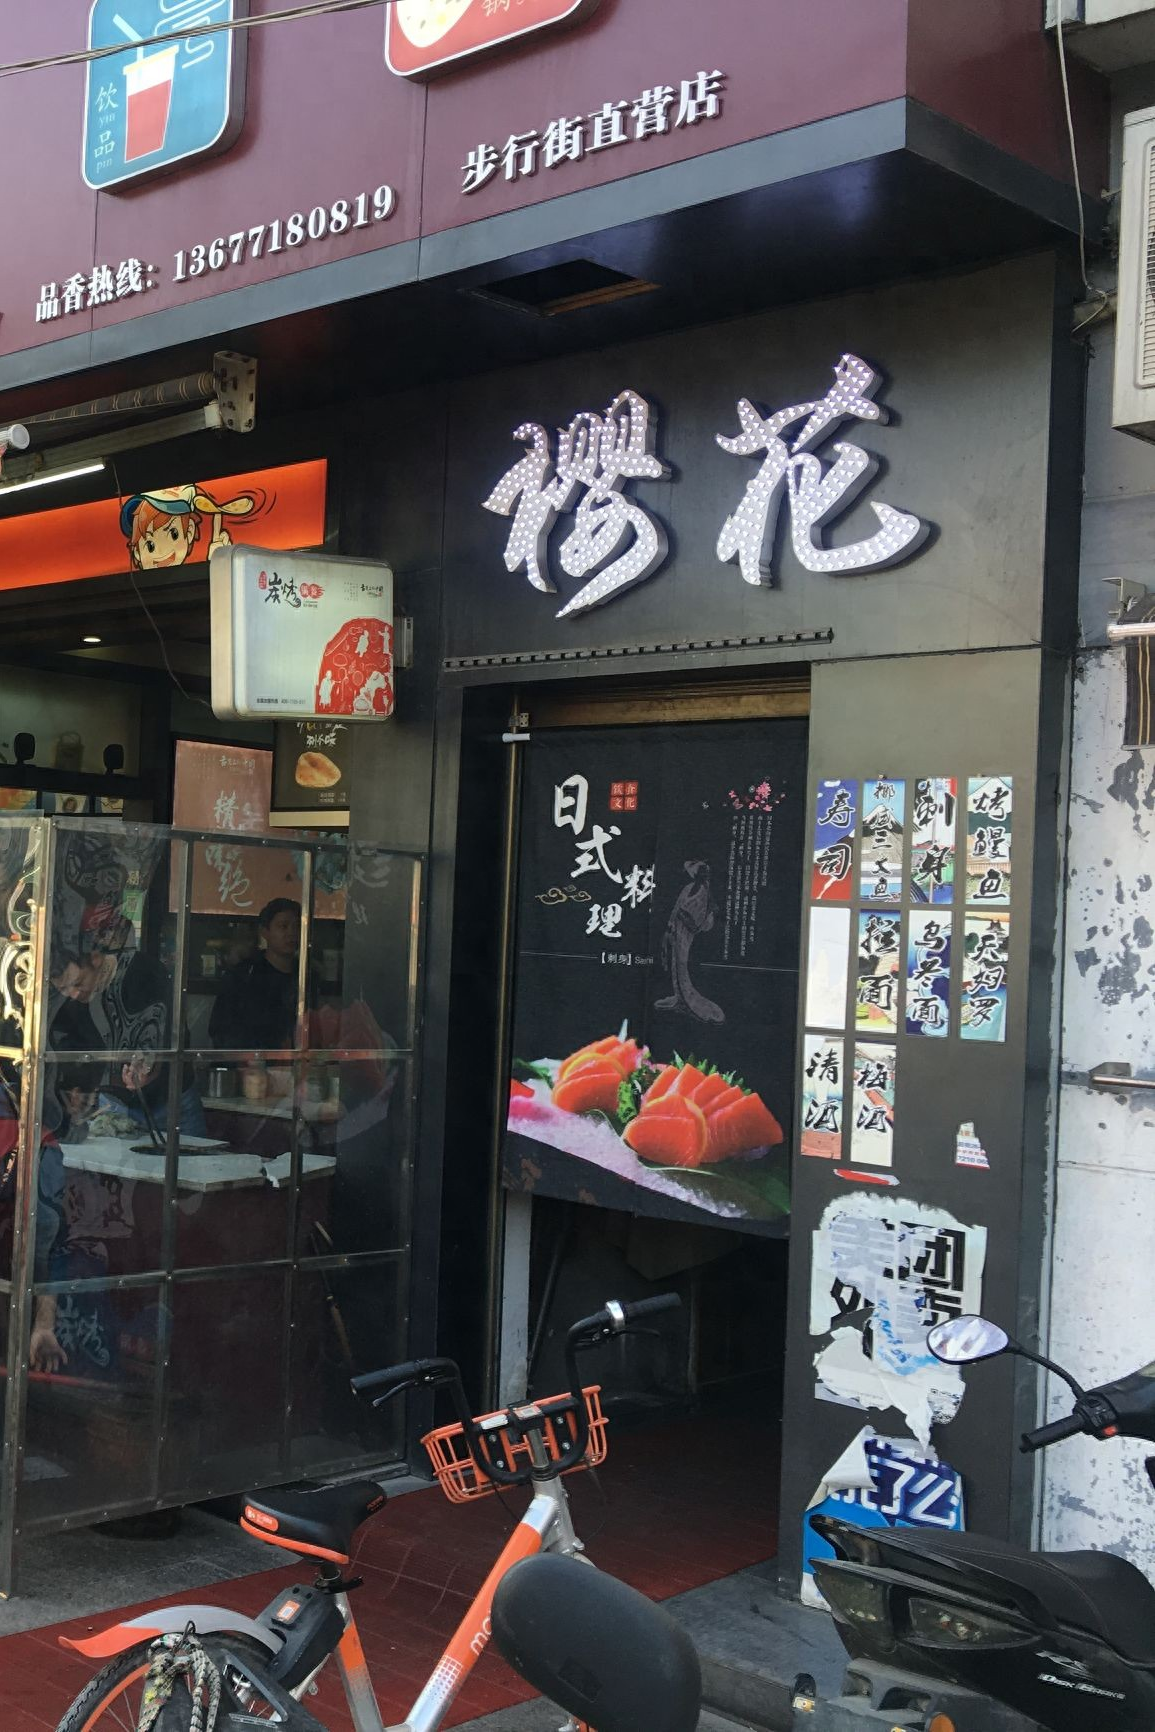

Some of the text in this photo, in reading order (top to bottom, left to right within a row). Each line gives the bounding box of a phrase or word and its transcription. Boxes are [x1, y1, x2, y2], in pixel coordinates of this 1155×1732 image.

[462, 69, 725, 193] 步行街直营店
[173, 185, 395, 282] 13677180819
[554, 774, 656, 938] 日式料理
[818, 788, 855, 881] 寿司
[916, 792, 956, 885] 刺身
[972, 787, 1010, 900] 烤鳗鱼
[805, 1048, 840, 1133] 清酒
[857, 1063, 891, 1133] 梅酒
